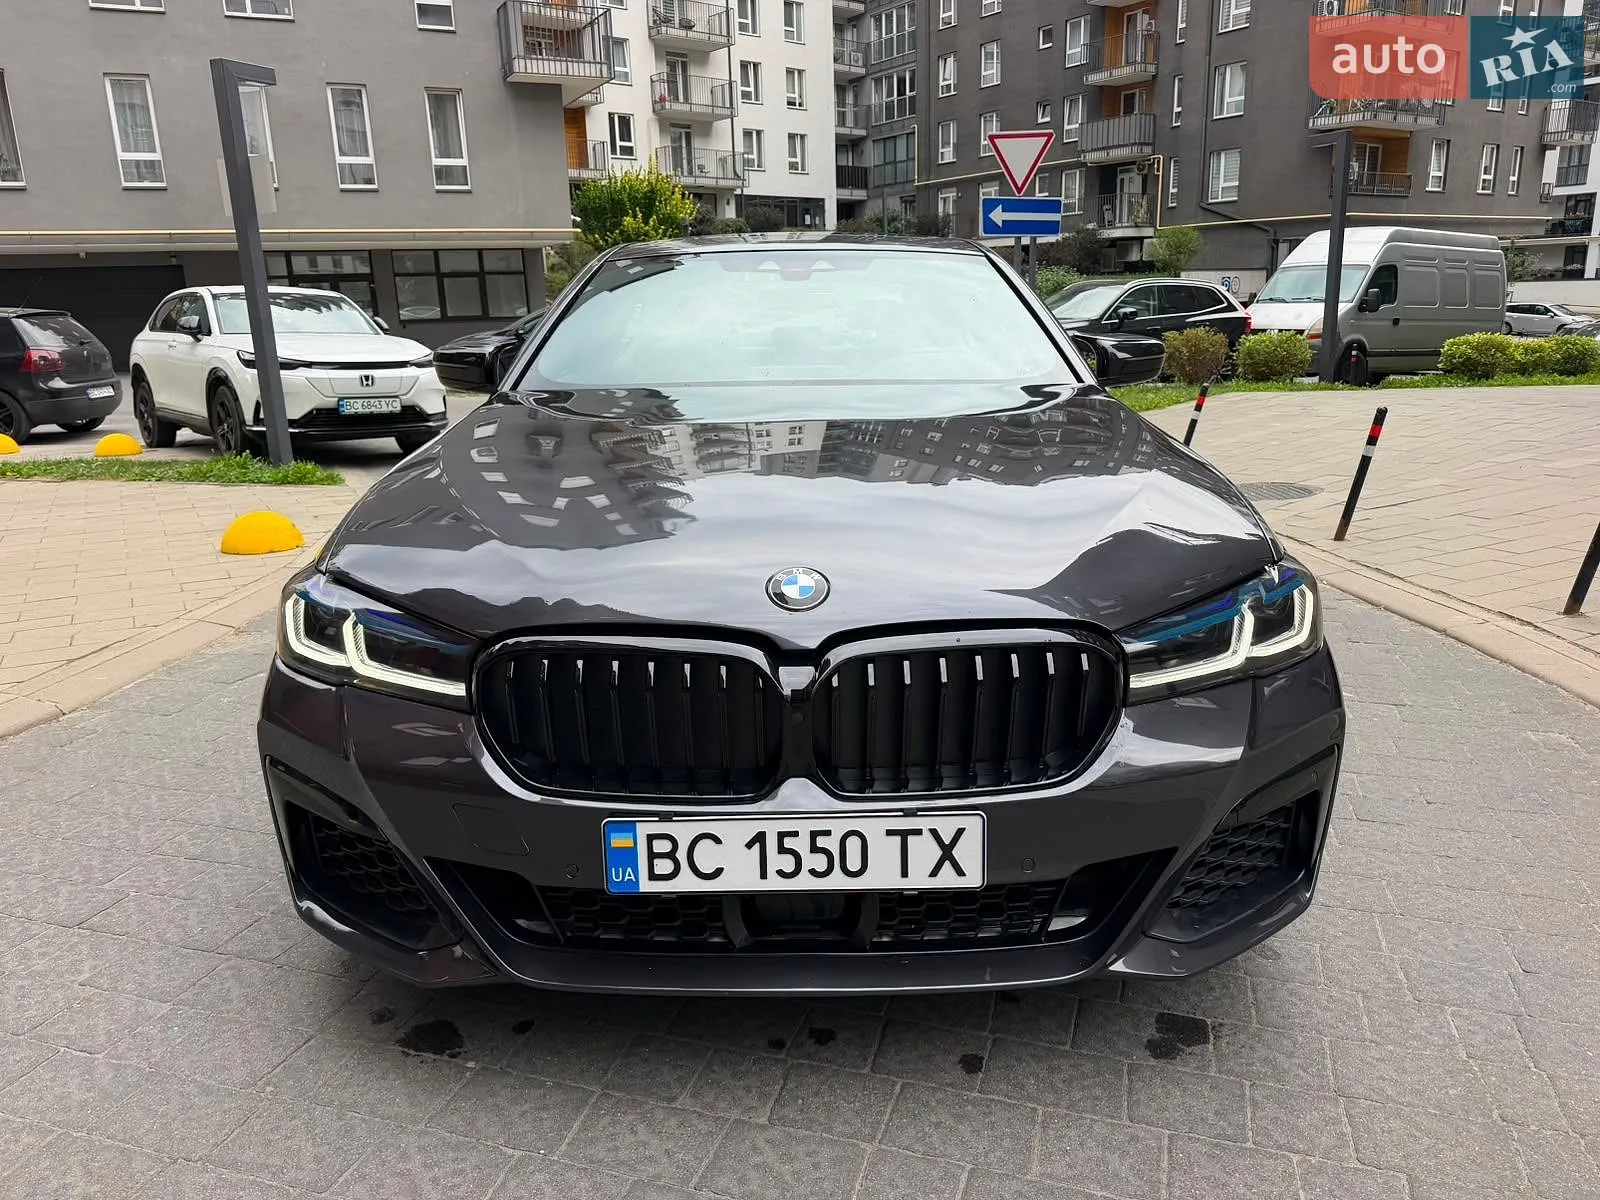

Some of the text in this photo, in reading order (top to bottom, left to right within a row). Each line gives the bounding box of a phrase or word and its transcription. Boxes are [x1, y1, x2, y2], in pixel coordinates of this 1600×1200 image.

[345, 400, 398, 410] BC 6843 YC
[646, 827, 967, 882] BC 1550 TX
[611, 867, 636, 882] UA
